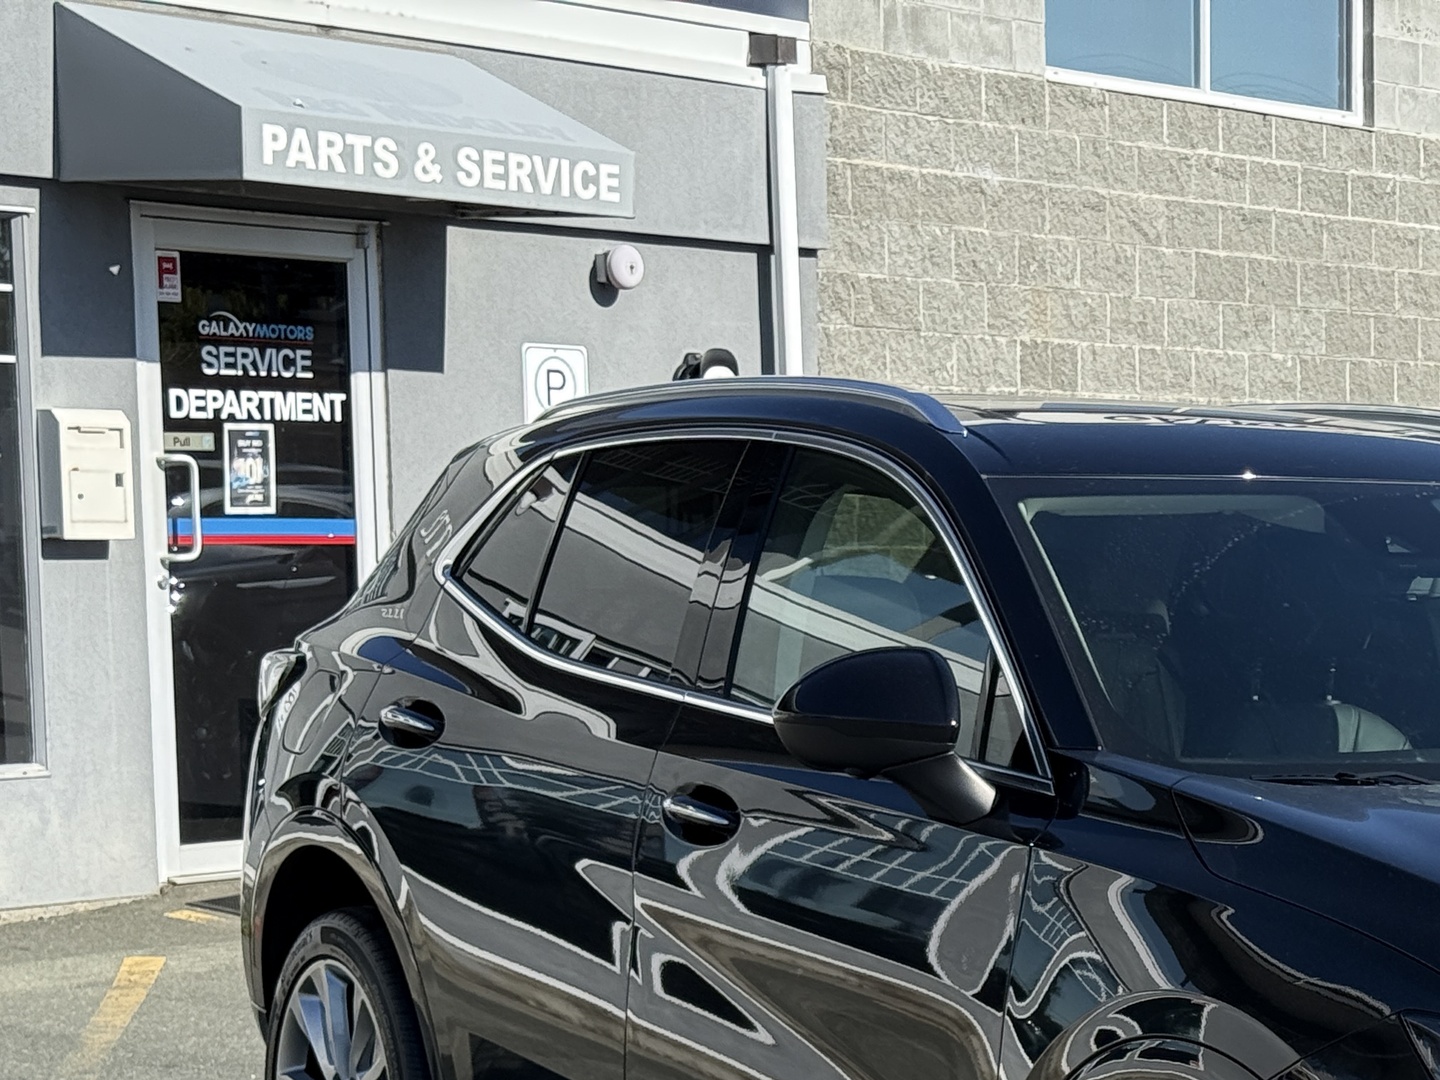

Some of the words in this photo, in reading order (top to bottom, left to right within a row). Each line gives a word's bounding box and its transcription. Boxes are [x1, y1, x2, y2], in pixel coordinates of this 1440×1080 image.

[261, 123, 399, 178] PARTS
[413, 142, 443, 184] &
[456, 147, 621, 202] SERVICE
[198, 319, 314, 341] GALAXYMOTORS
[201, 345, 314, 379] SERVICE
[547, 368, 566, 406] P
[168, 388, 347, 423] DEPARTMENT
[173, 436, 191, 447] Pull
